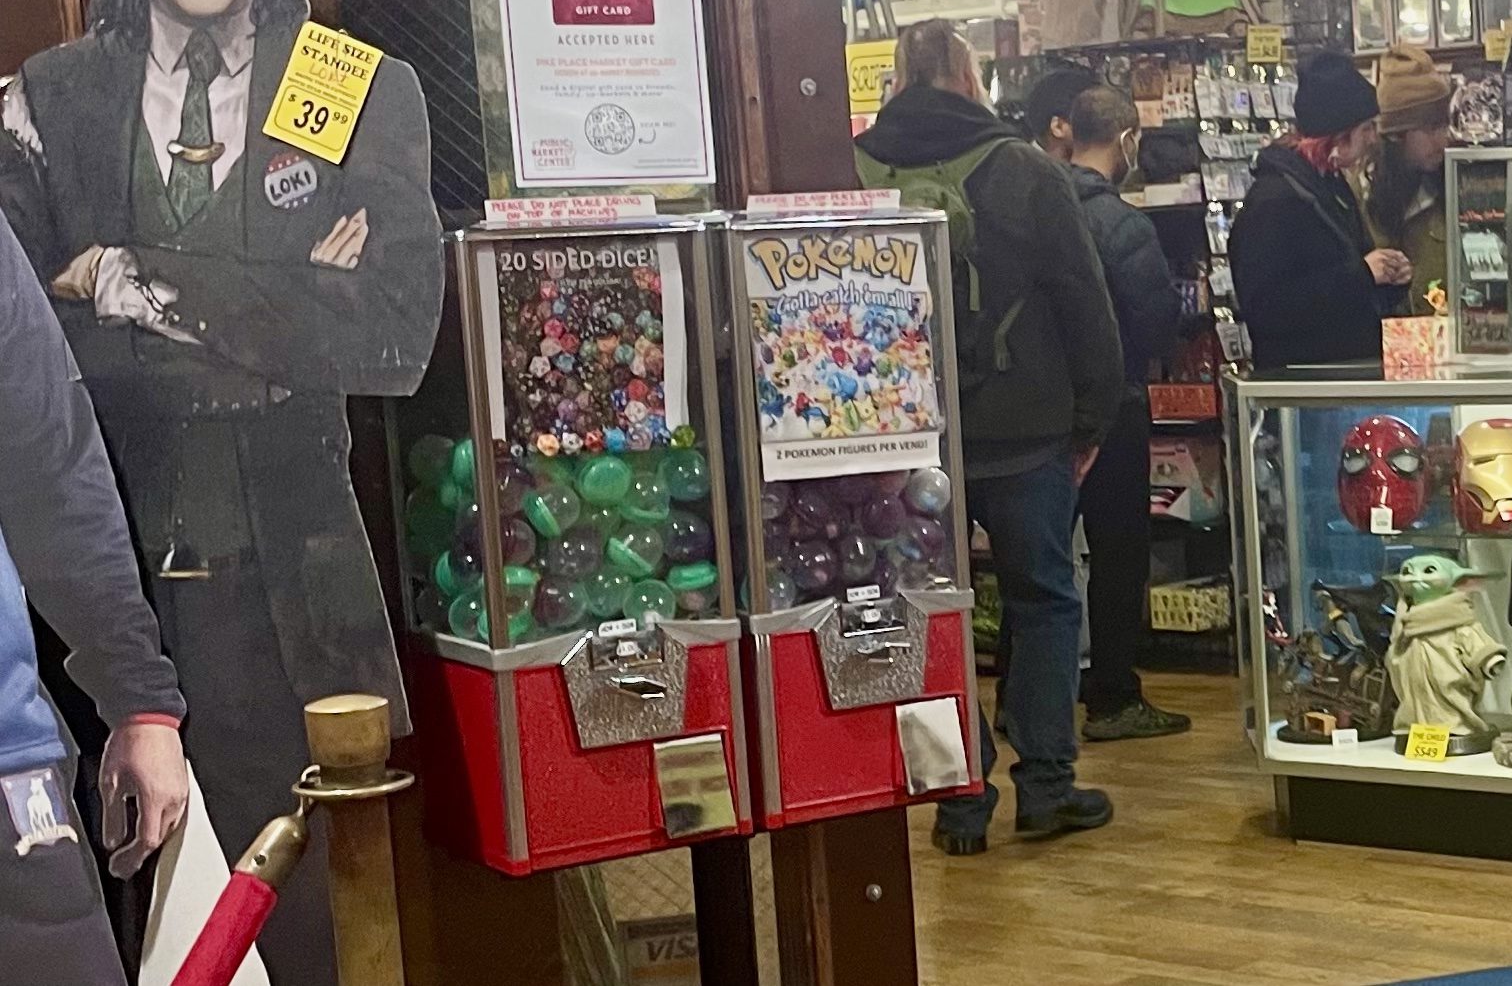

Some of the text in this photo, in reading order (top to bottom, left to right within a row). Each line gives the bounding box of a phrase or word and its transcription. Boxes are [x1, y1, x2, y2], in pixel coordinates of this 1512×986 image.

[575, 5, 632, 15] GIFT CARD
[308, 29, 375, 65] LIFE SIZE
[557, 34, 656, 46] ACCEPTED HERE
[301, 45, 370, 81] STANDEE
[293, 100, 330, 136] 39
[268, 170, 312, 202] LOKI
[500, 251, 526, 272] 20
[532, 249, 596, 272] SIDED
[776, 449, 783, 460] 2
[784, 446, 836, 460] POKEMON
[838, 442, 878, 455] FIGURES
[879, 441, 898, 452] PER
[644, 933, 698, 962] VIS
